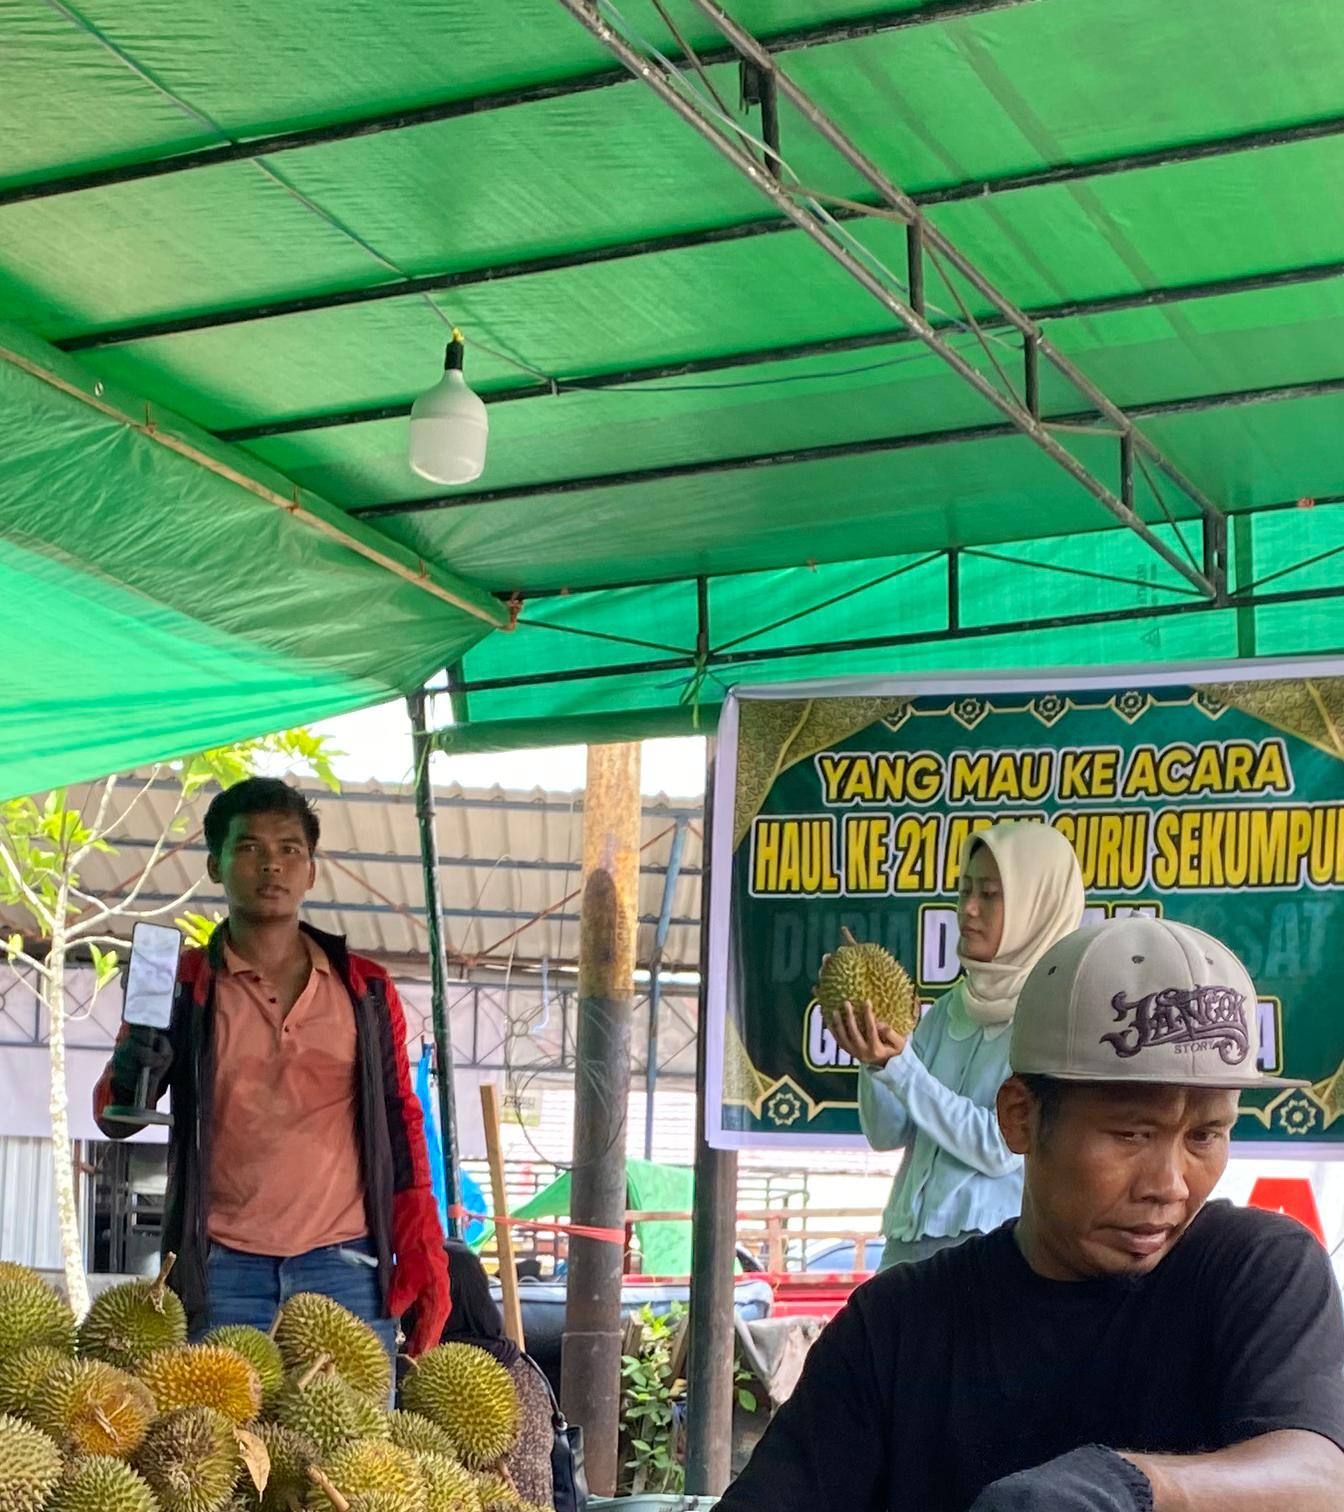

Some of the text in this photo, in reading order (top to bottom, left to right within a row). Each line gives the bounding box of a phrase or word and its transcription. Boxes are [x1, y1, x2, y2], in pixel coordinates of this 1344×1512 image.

[819, 742, 1289, 802] YANG MAU KE ACARA
[754, 818, 840, 893] HAUL
[843, 816, 889, 892] KE
[894, 814, 939, 892] 21
